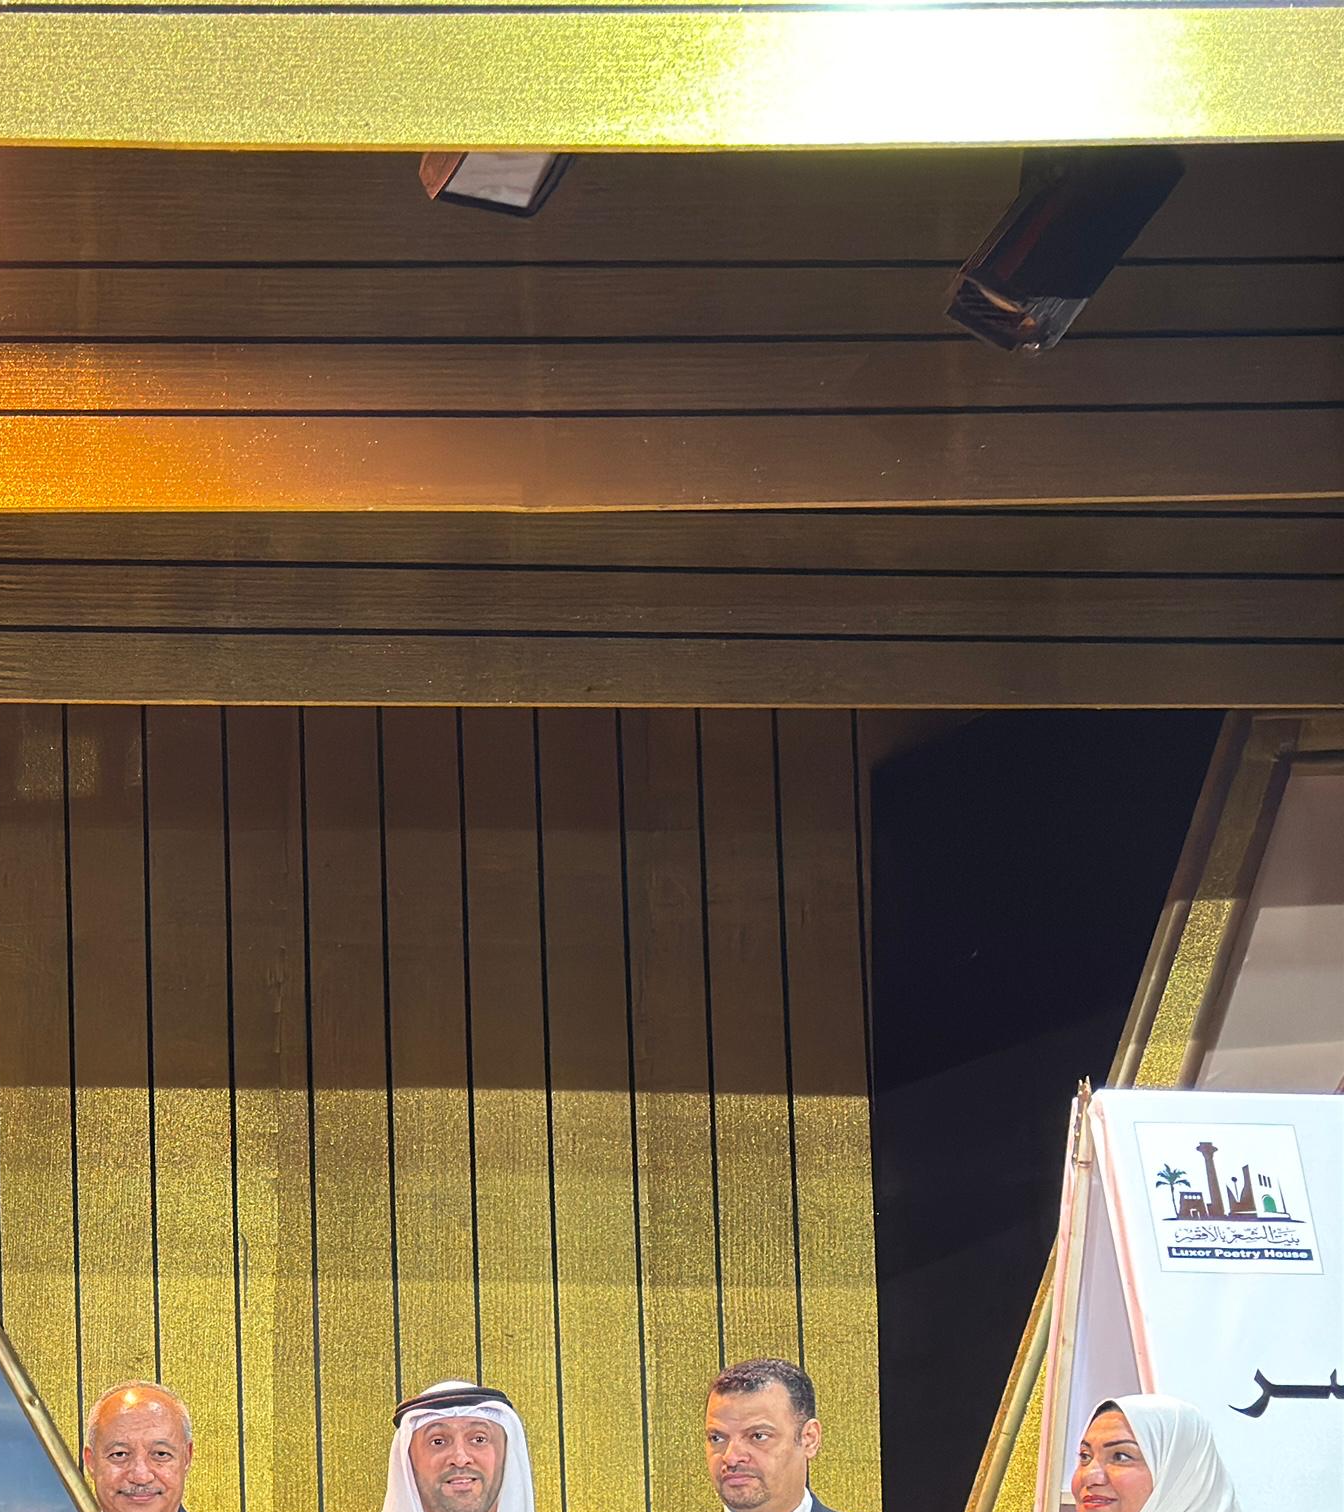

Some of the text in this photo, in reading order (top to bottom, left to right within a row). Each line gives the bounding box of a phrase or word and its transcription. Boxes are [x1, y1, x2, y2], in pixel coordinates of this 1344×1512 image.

[1171, 1248, 1309, 1260] Luxor Poetry House
